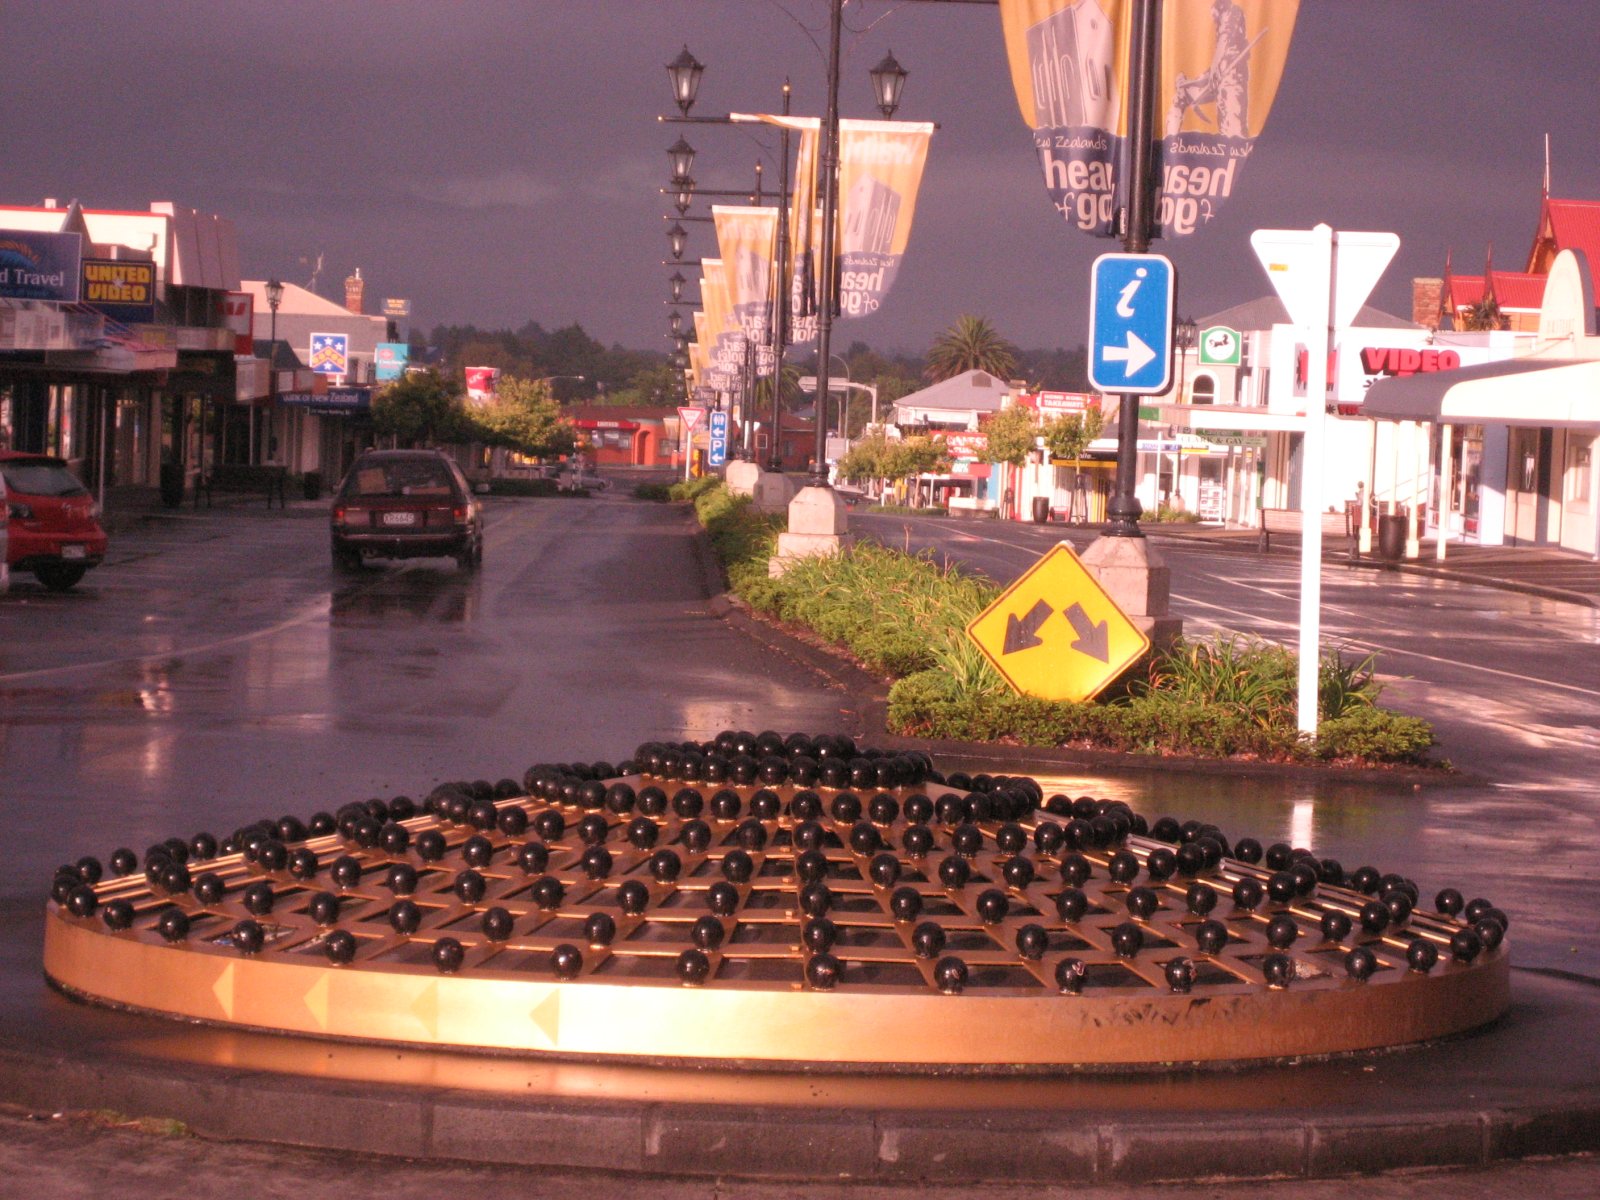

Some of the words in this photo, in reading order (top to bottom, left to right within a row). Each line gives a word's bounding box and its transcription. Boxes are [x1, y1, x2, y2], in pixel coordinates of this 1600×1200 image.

[14, 269, 64, 287] Travel
[85, 265, 151, 283] UNITED
[88, 283, 146, 301] VIDEO
[1360, 347, 1460, 375] VIDEO
[713, 440, 722, 451] P
